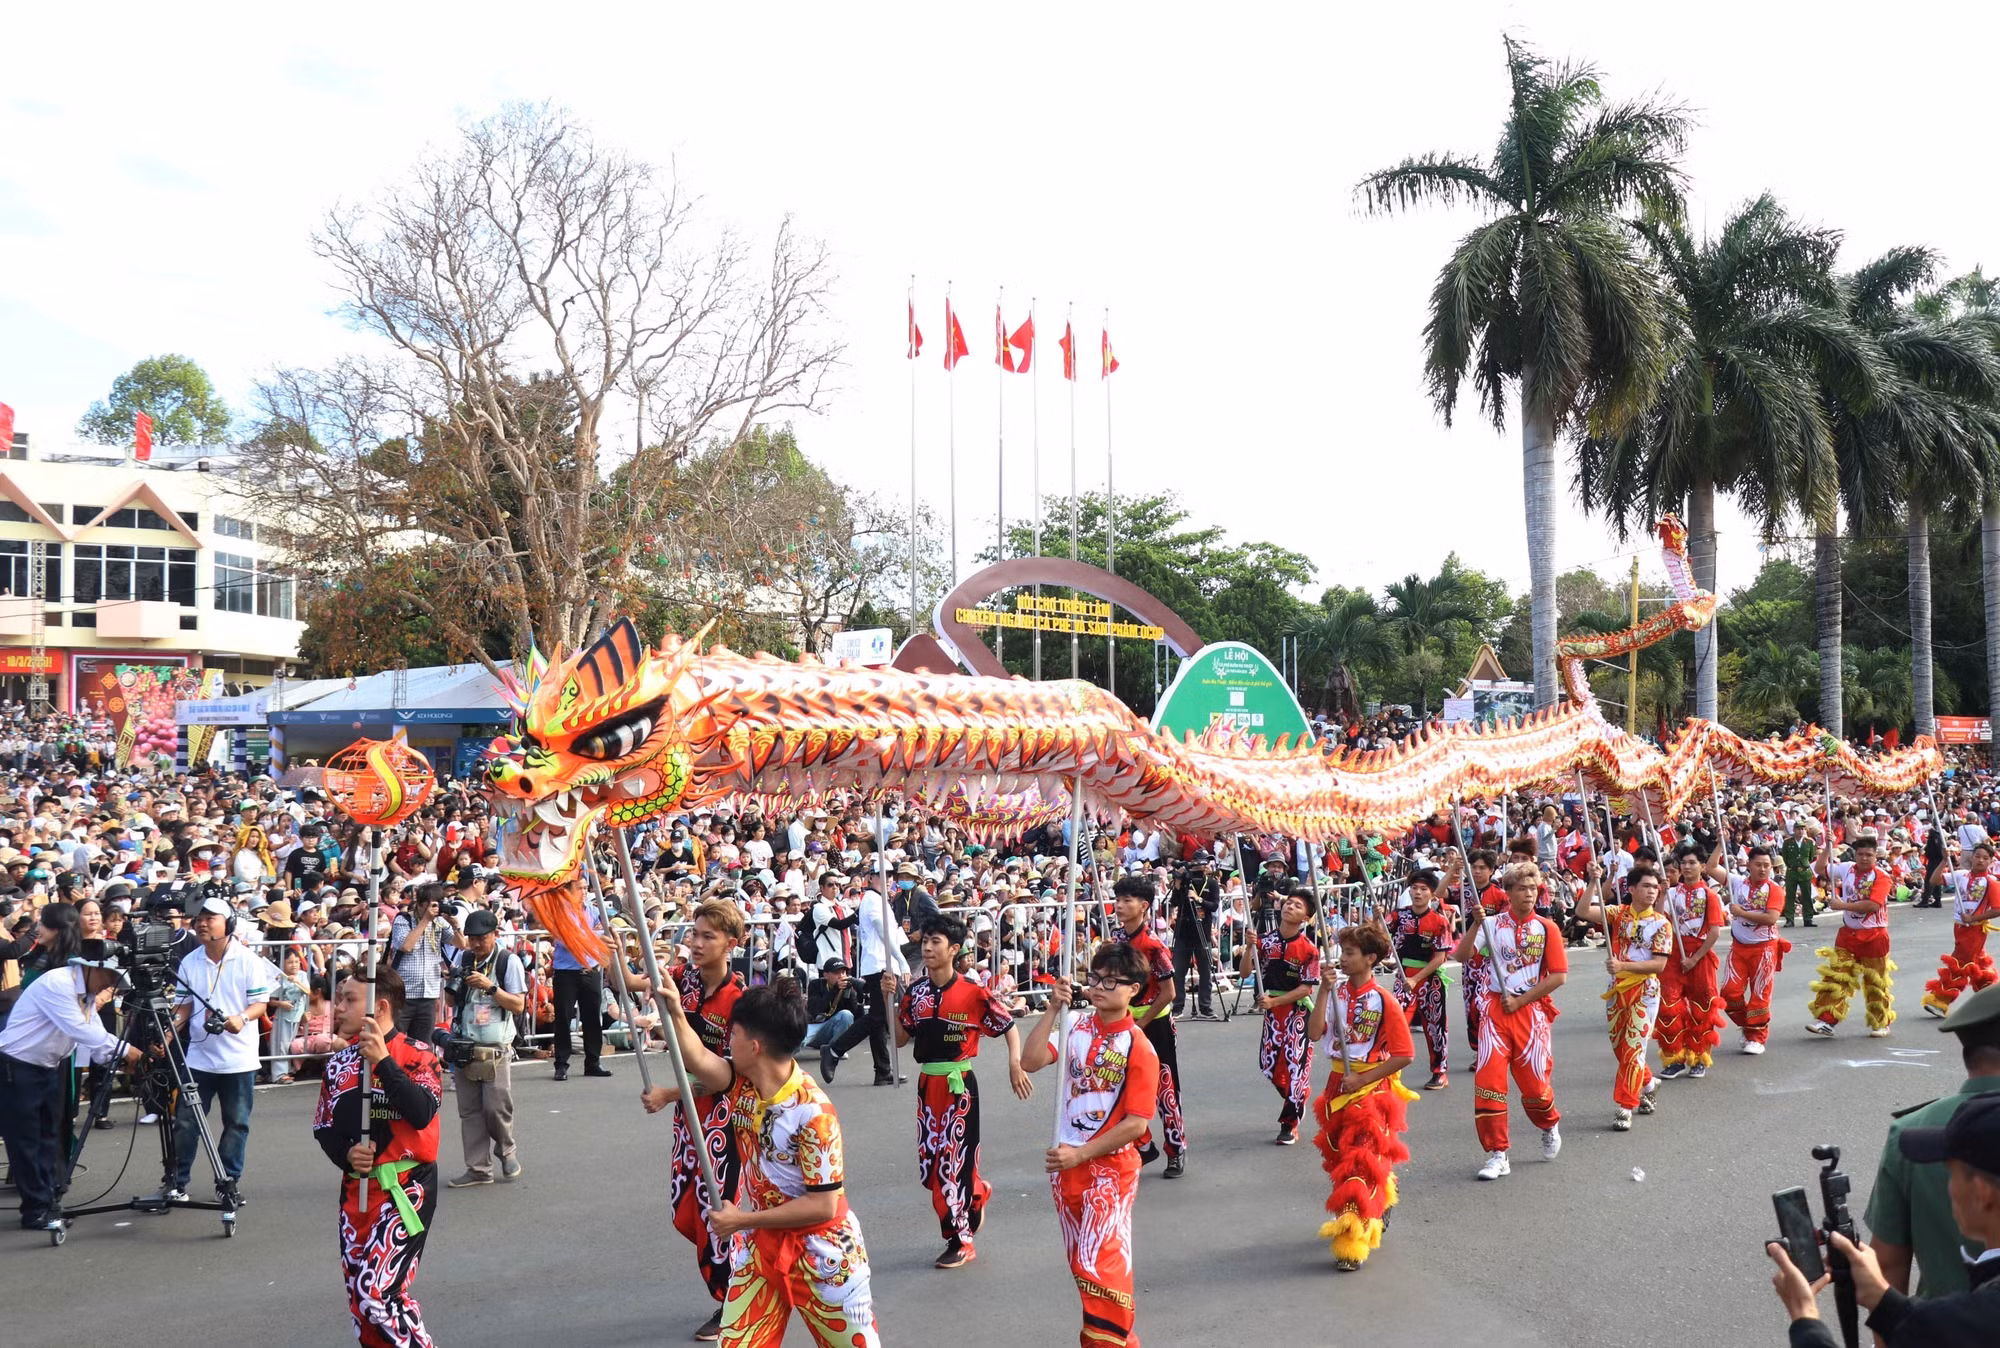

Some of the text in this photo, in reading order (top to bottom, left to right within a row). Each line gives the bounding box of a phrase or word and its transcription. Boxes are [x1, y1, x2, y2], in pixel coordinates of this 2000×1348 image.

[1036, 596, 1057, 615] CHỢ
[1037, 613, 1050, 631] CÀ
[1052, 614, 1071, 633] PHÊ
[1074, 616, 1086, 634] VÀ
[1224, 648, 1248, 662] LỄ HỘI
